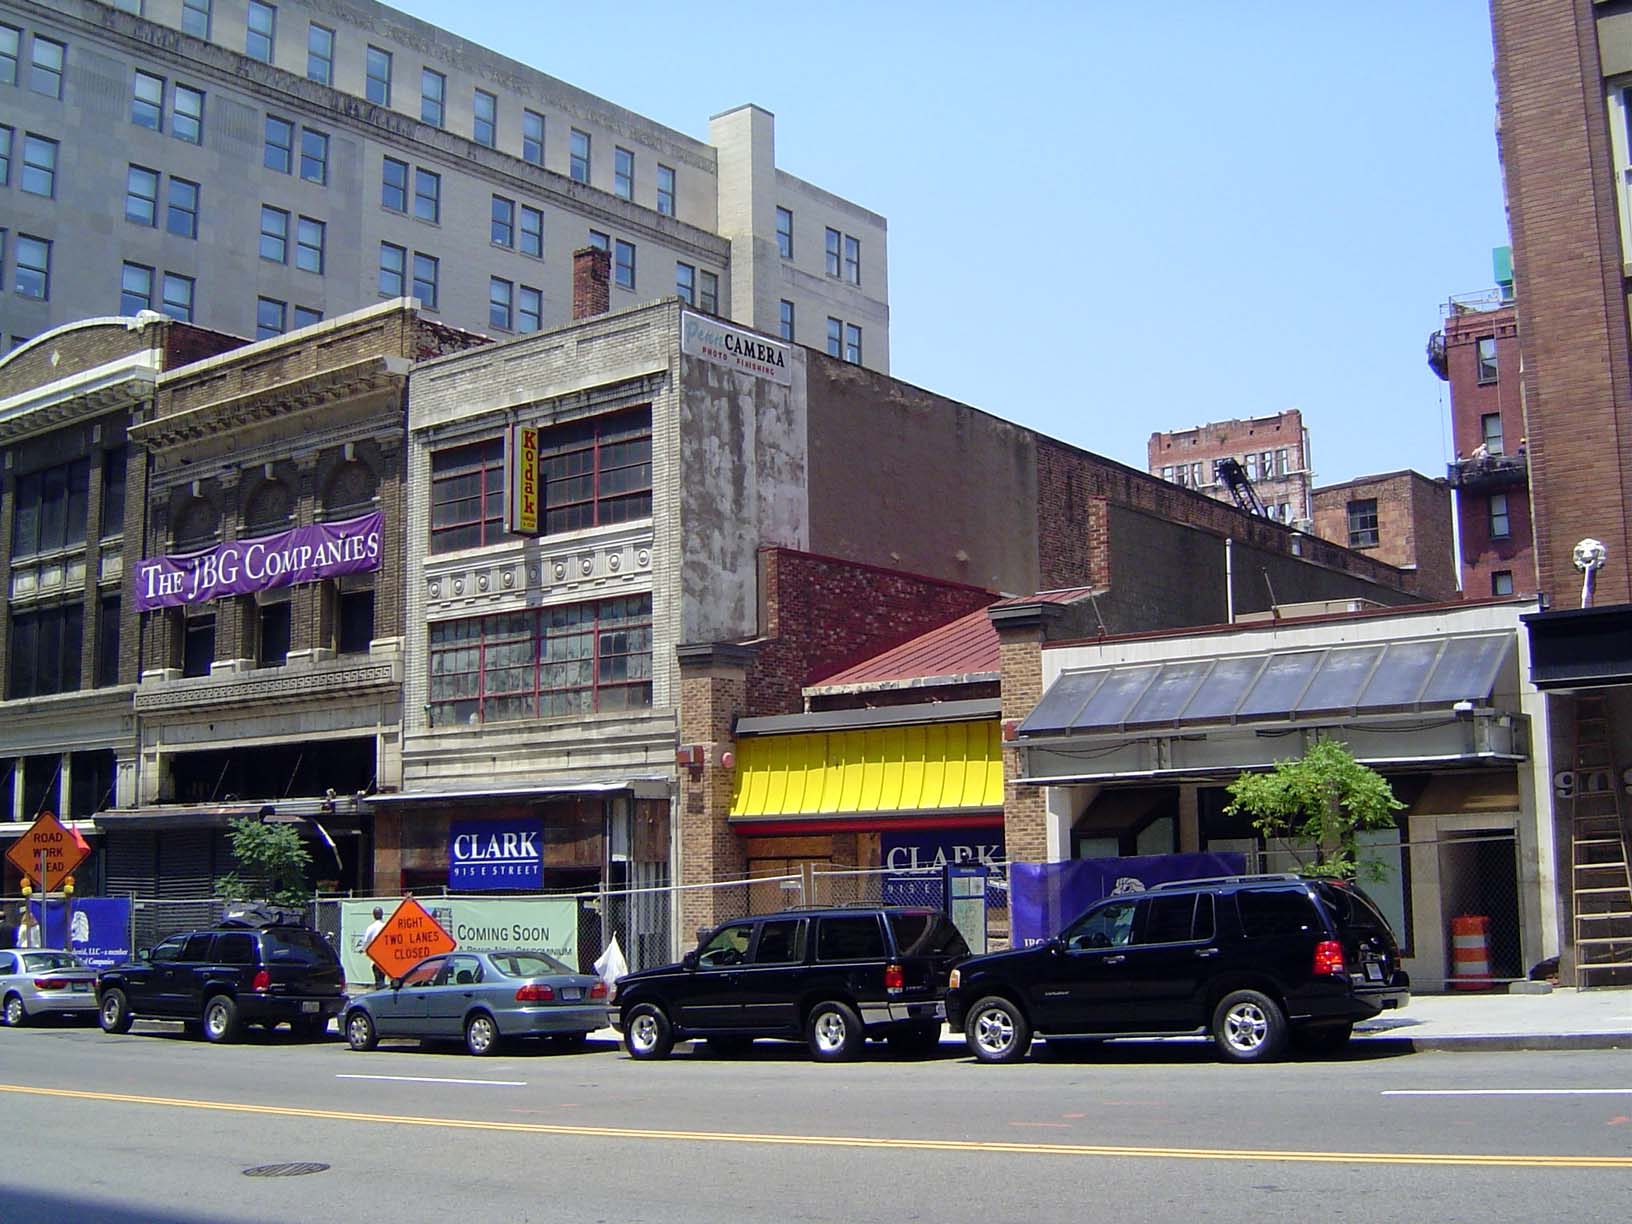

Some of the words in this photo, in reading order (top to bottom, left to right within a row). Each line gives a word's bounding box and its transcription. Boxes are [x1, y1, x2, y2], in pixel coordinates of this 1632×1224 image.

[702, 346, 728, 361] PHOTO
[736, 358, 776, 376] FINISHING
[724, 333, 785, 368] CAMERA
[523, 430, 537, 514] Kodak
[142, 563, 185, 599] THE
[188, 549, 239, 599] JBG
[244, 531, 379, 580] COMPANIES
[33, 832, 63, 843] ROAD
[454, 831, 539, 860] CLARK
[454, 866, 476, 877] 915
[481, 867, 487, 876] E
[492, 865, 538, 876] STREET
[886, 844, 1001, 875] CLARK
[398, 917, 423, 929] RIGHT
[457, 924, 509, 941] COMING
[512, 924, 550, 941] SOON
[384, 934, 404, 945] TWO
[409, 931, 440, 944] LANES
[394, 947, 430, 960] CLOSED
